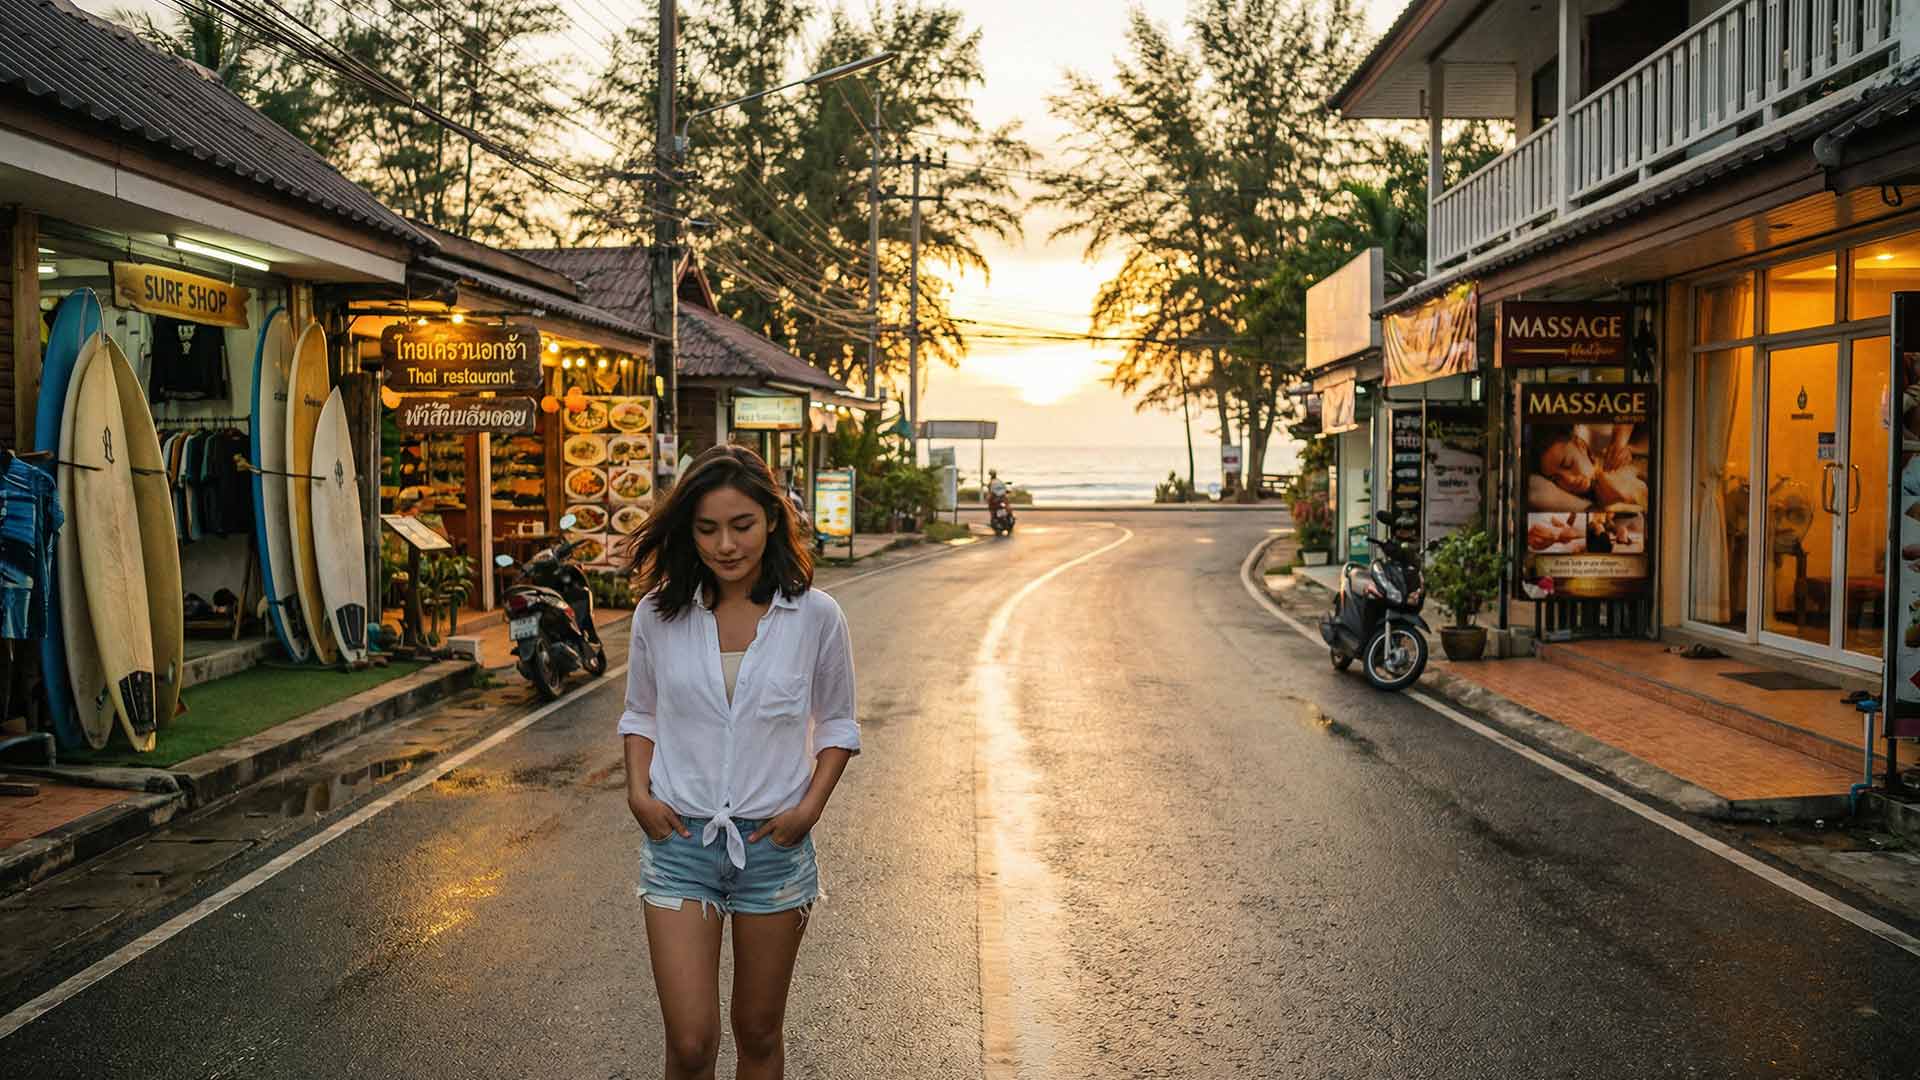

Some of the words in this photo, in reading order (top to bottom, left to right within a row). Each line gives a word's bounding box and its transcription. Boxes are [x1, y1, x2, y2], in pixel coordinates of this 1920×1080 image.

[144, 274, 183, 306] SURF
[188, 284, 227, 313] SHOP
[1507, 315, 1622, 338] MASSAGE
[407, 367, 437, 385] Thai
[443, 367, 516, 385] restaurant
[1528, 392, 1647, 414] MASSAGE
